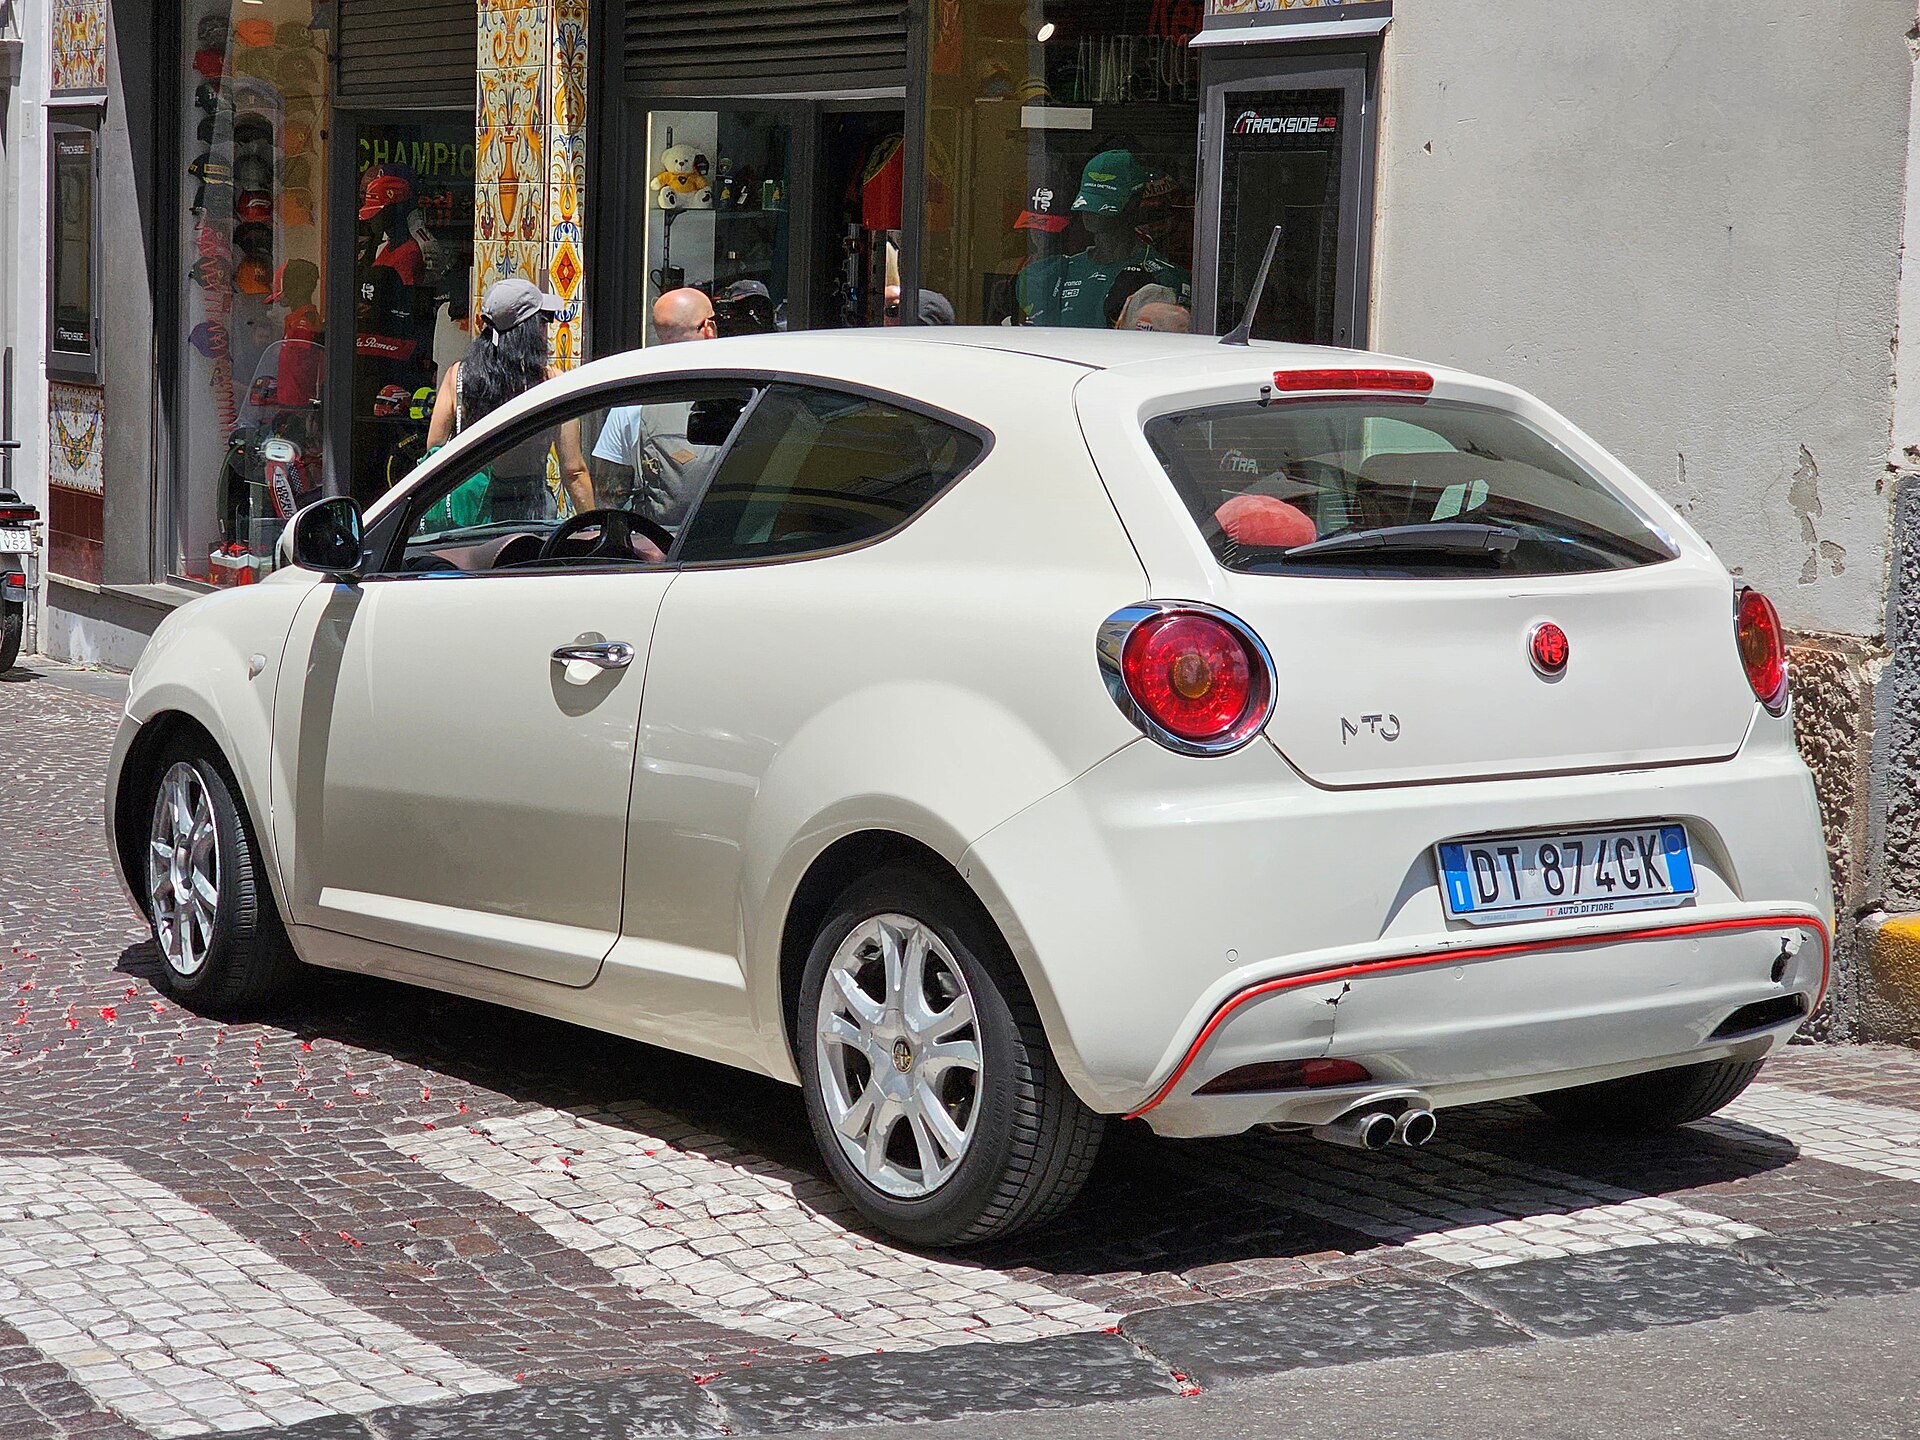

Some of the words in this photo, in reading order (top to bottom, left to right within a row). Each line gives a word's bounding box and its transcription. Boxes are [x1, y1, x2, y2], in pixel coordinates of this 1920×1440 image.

[1246, 116, 1319, 134] TRACKSIDE
[1318, 117, 1336, 127] LAB
[364, 336, 399, 351] Romeo
[1232, 456, 1258, 475] TRA
[3, 539, 27, 550] V52
[1470, 846, 1521, 904] DT
[1538, 834, 1667, 896] 874GK
[1557, 905, 1579, 916] AUTO
[1580, 904, 1590, 913] DI
[1591, 902, 1615, 912] FIORE
